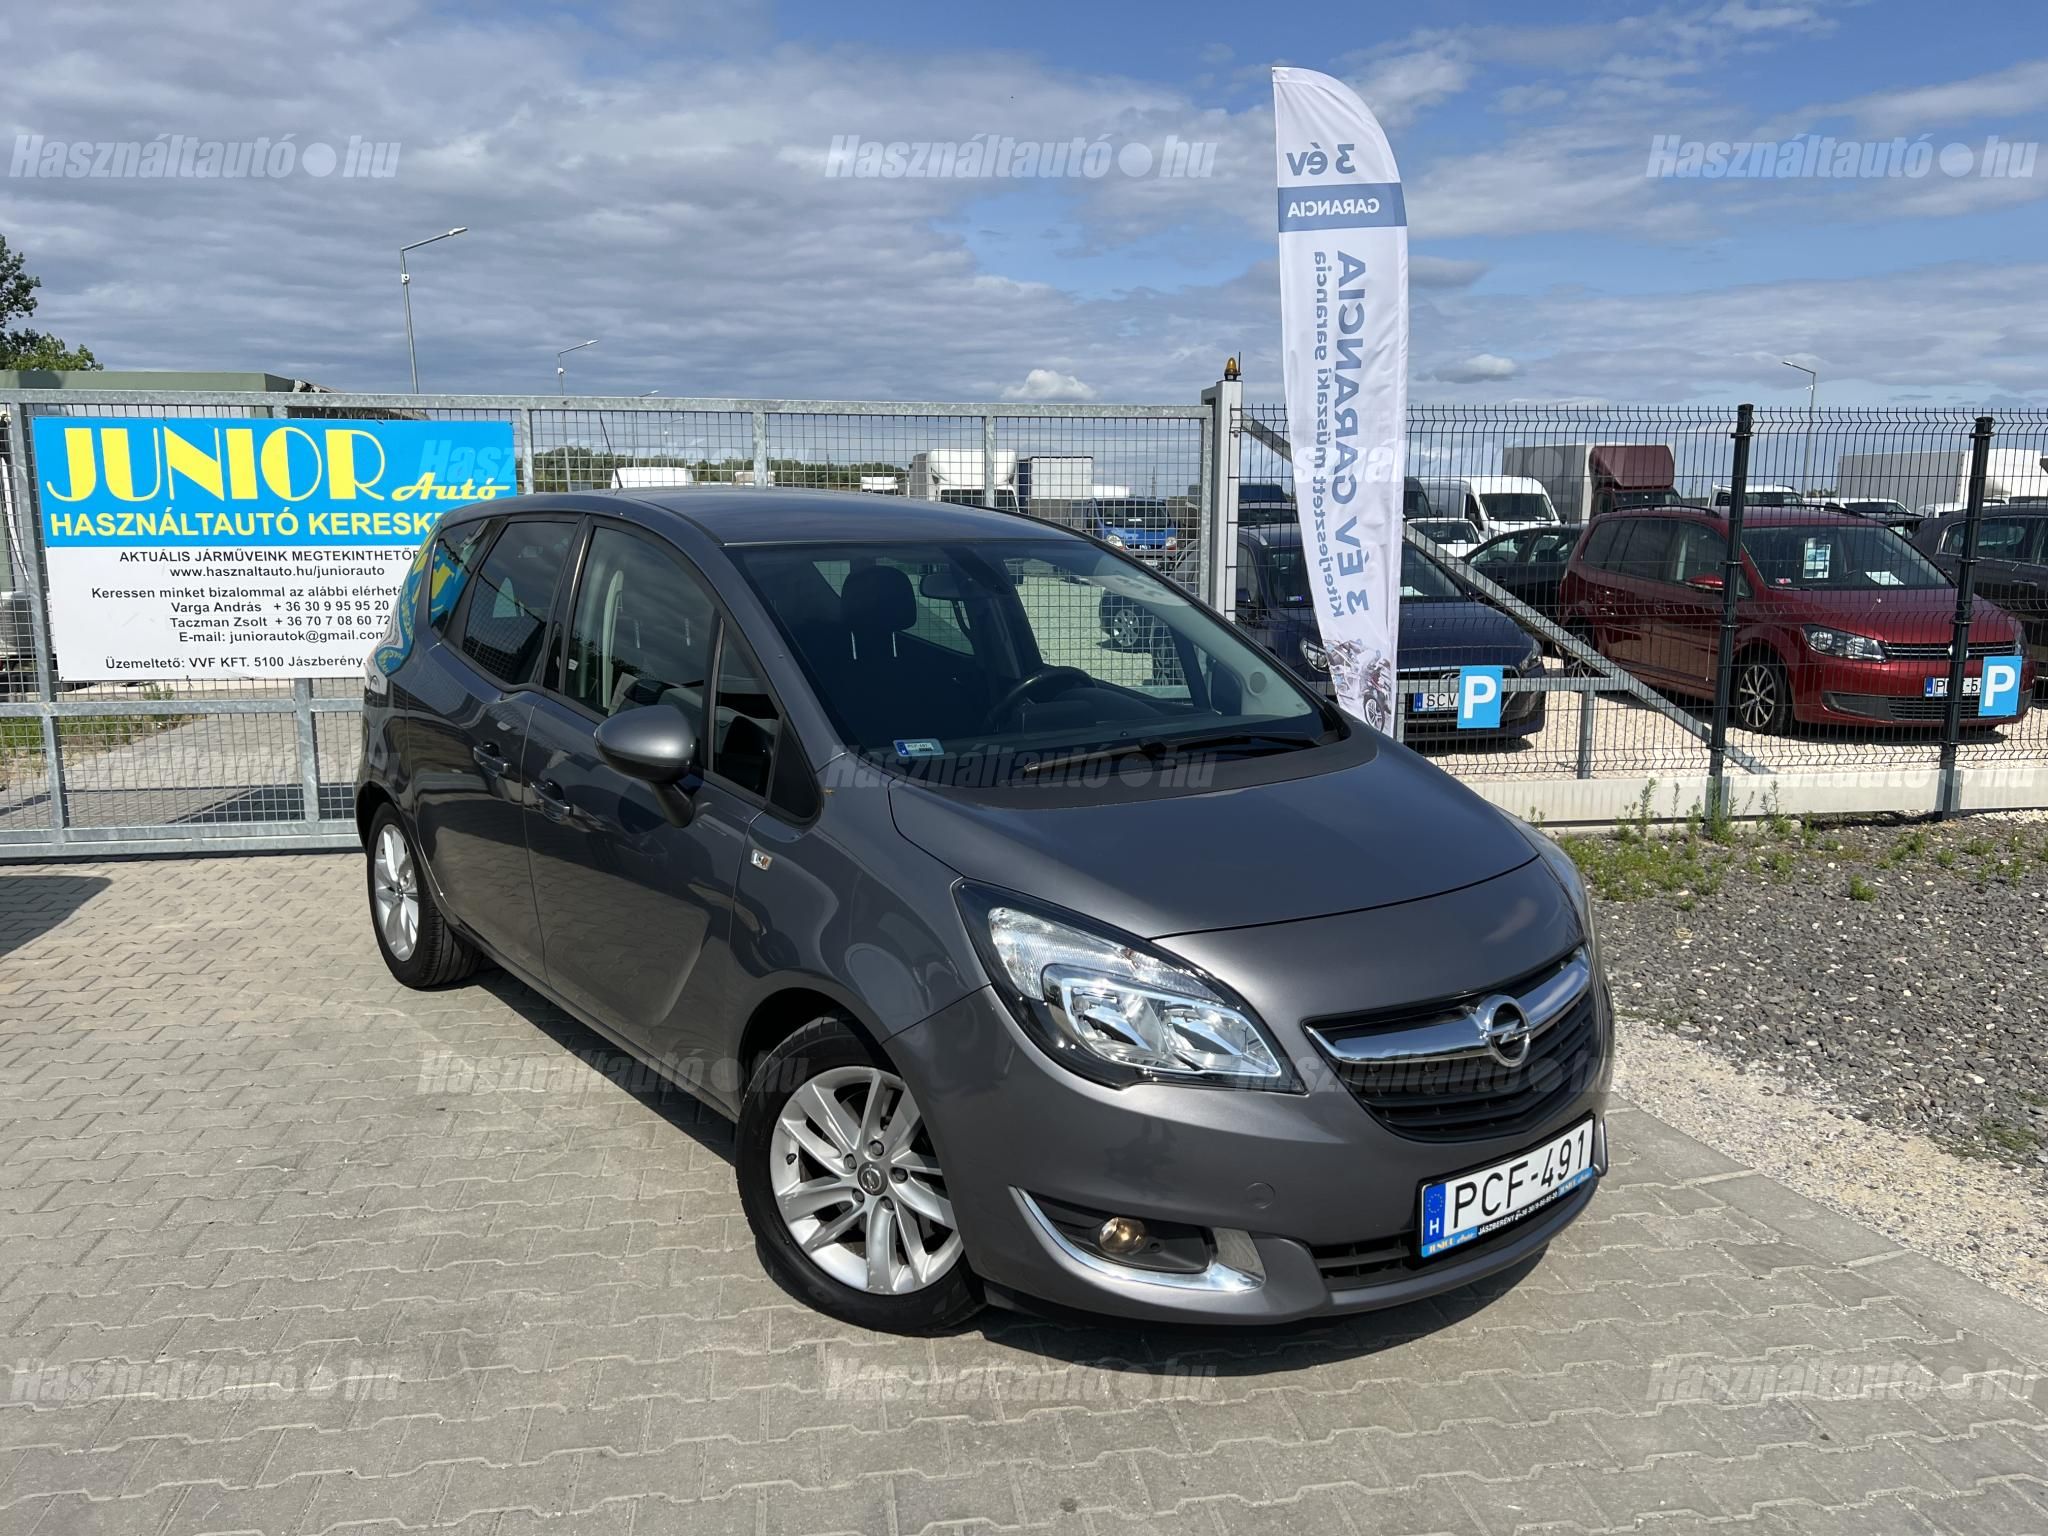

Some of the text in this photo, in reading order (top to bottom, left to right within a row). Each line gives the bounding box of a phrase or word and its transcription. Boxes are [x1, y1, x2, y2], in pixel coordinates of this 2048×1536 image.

[47, 426, 511, 502] JUNIOR Autó
[50, 506, 299, 537] HASZNÁLTAUTÓ
[119, 548, 190, 562] AKTUÁLIS
[195, 547, 288, 562] JÁRMŰVEINK
[170, 565, 385, 579] www.hasznaltauto.hu/juniorauto
[92, 587, 155, 598] Keressen
[160, 587, 205, 598] minket
[209, 586, 285, 598] bizalommal
[289, 589, 303, 597] az
[308, 586, 347, 597] alábbi
[171, 600, 389, 615] Varga András + 36 30 9 95 95 20
[170, 615, 390, 628] Taczman Zsolt + 36 70 7 08 60 72
[179, 629, 384, 645] E-mail: juniorautok@gmail.com
[105, 656, 185, 669] Üzemeltető:
[189, 657, 216, 668] VVF
[221, 657, 250, 668] KFT.
[254, 656, 284, 667] 5100
[1984, 664, 2016, 707] P
[1427, 693, 1457, 706] SCV
[1463, 675, 1496, 719] P
[1429, 1129, 1585, 1236] H PCF-491
